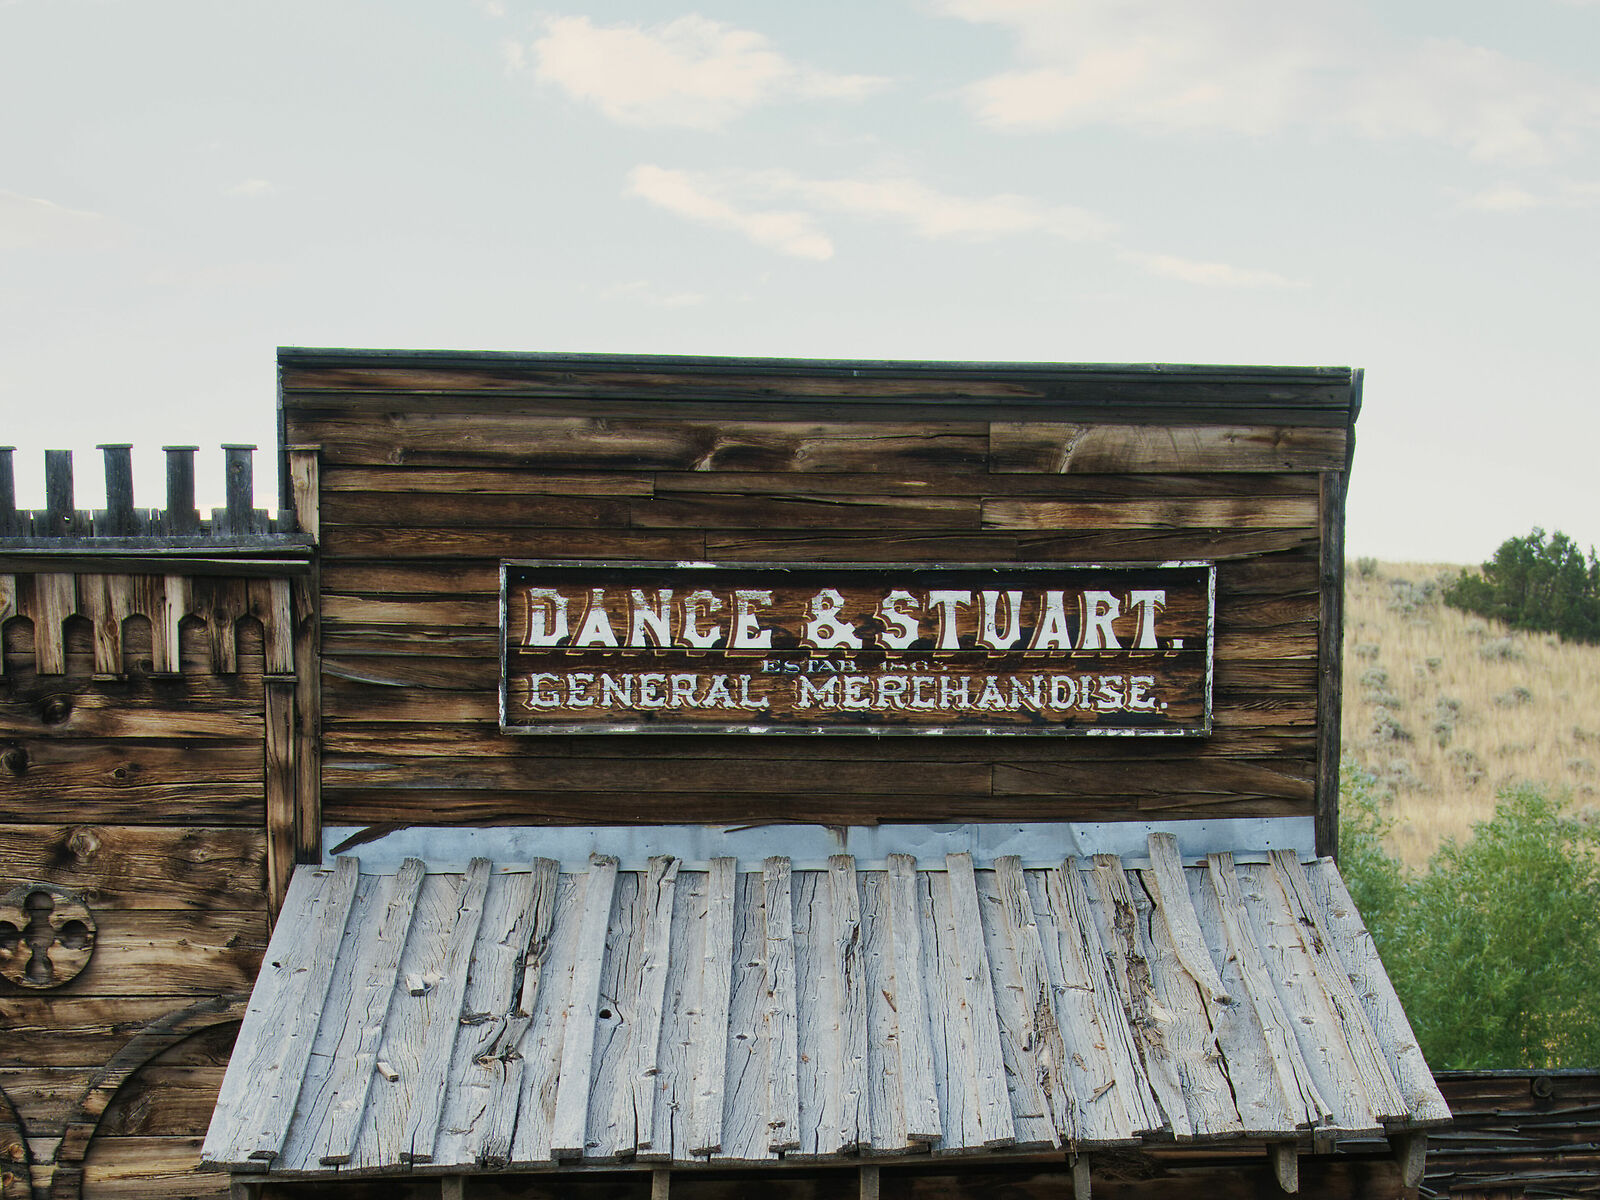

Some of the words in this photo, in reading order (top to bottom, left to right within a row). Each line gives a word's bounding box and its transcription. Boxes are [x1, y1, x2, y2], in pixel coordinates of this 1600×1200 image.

[524, 588, 774, 651] DANCE
[804, 587, 863, 651] &
[877, 589, 1184, 651] STUART.
[526, 672, 770, 710] GENERAL
[796, 674, 1168, 711] MERCHANDISE.
